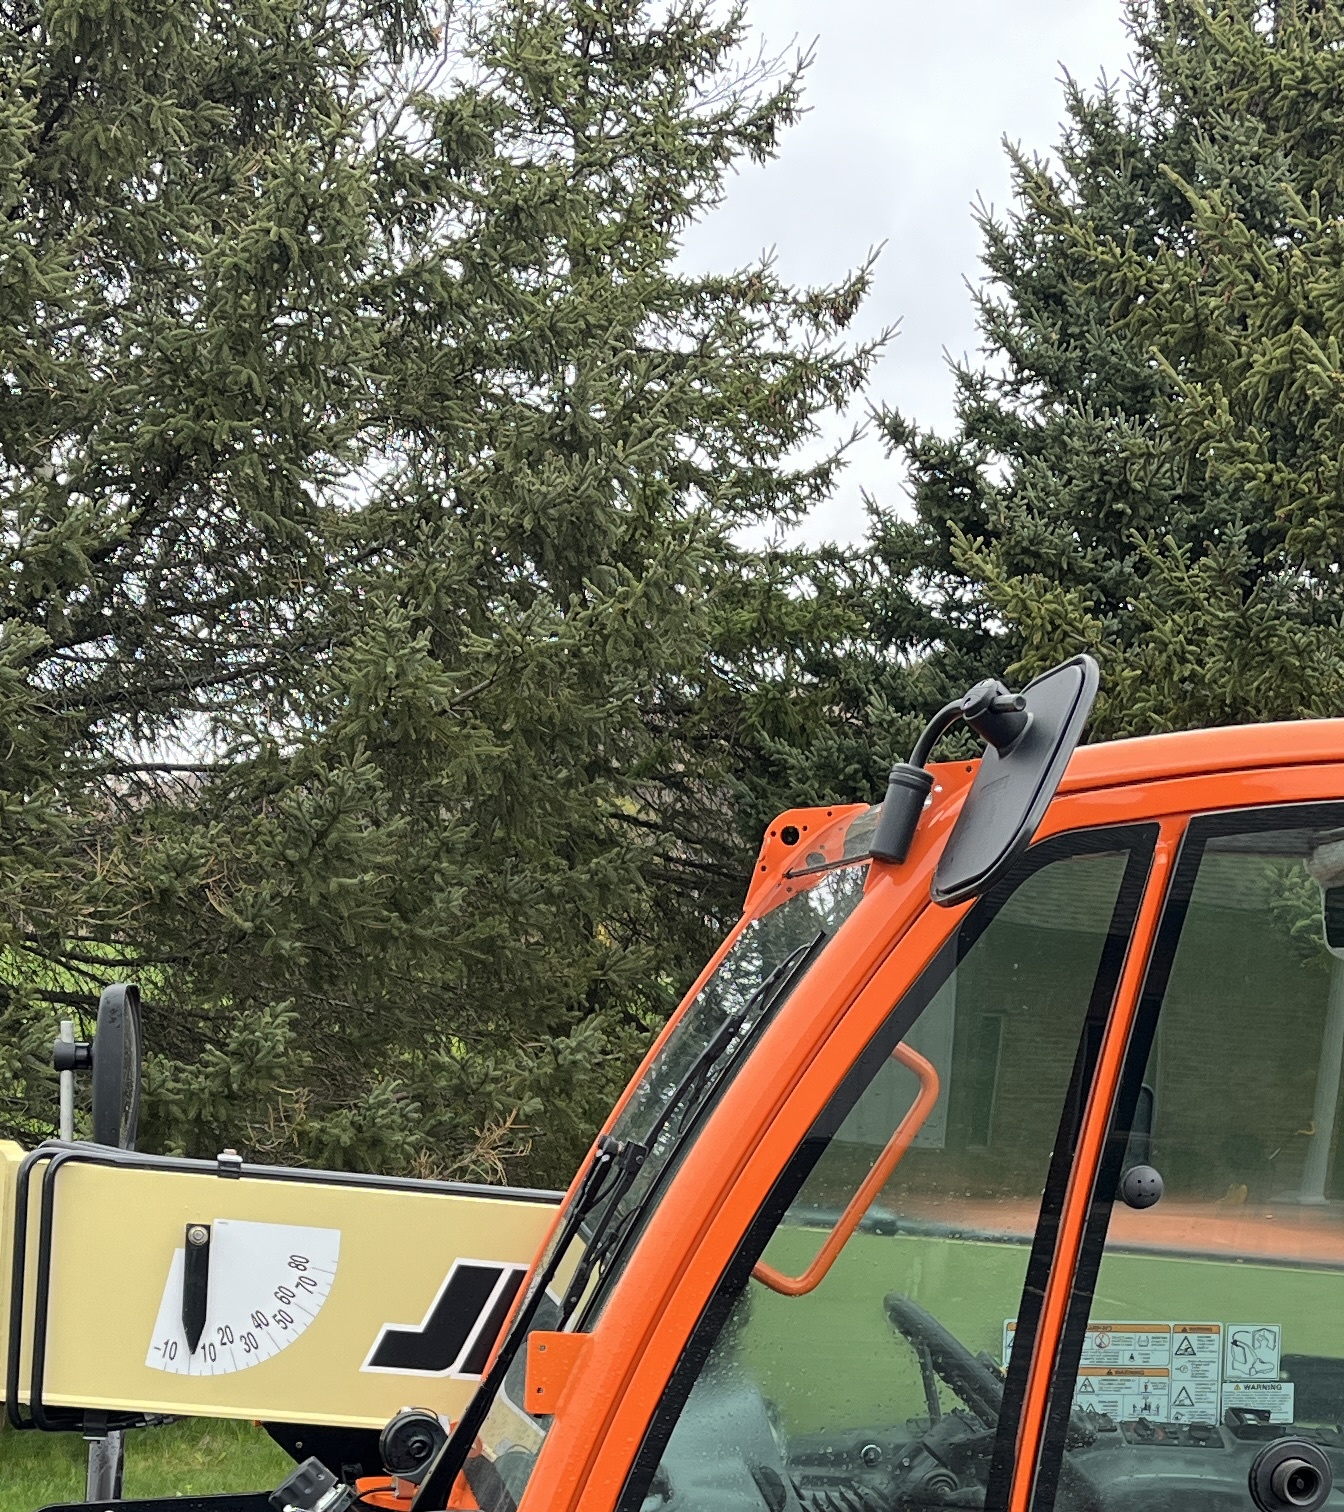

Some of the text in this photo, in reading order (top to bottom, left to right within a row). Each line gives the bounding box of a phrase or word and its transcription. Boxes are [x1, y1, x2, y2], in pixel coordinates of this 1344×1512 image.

[287, 1253, 311, 1272] 80
[295, 1275, 318, 1295] 70
[273, 1285, 297, 1307] 60
[250, 1309, 270, 1331] 40
[271, 1308, 295, 1330] 50
[217, 1324, 235, 1347] 20
[239, 1331, 260, 1353] 30
[153, 1340, 178, 1361] -10
[200, 1343, 217, 1363] 10
[1243, 1383, 1283, 1391] WARNING
